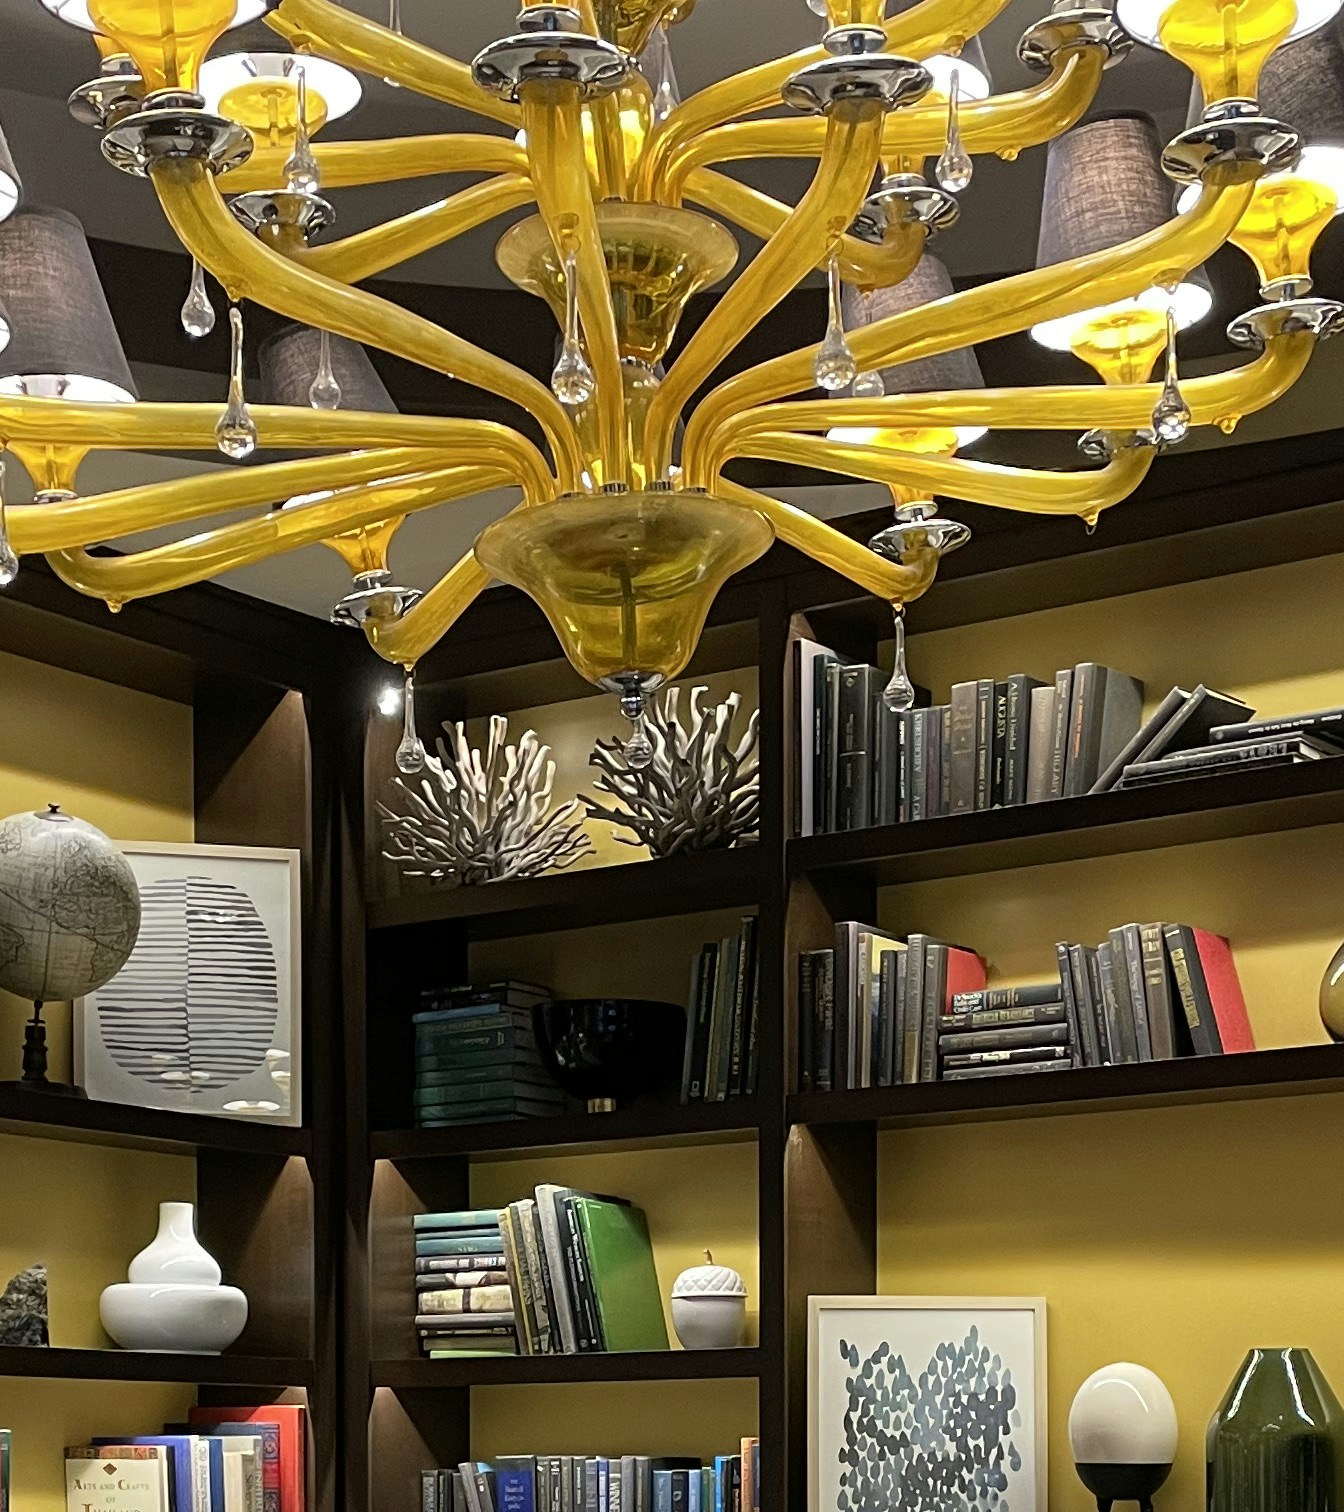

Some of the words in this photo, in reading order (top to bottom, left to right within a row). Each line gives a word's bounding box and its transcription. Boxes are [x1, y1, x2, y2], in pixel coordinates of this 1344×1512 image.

[74, 1478, 96, 1490] ARTS
[117, 1478, 151, 1491] CRAFTS
[105, 1496, 116, 1504] OF
